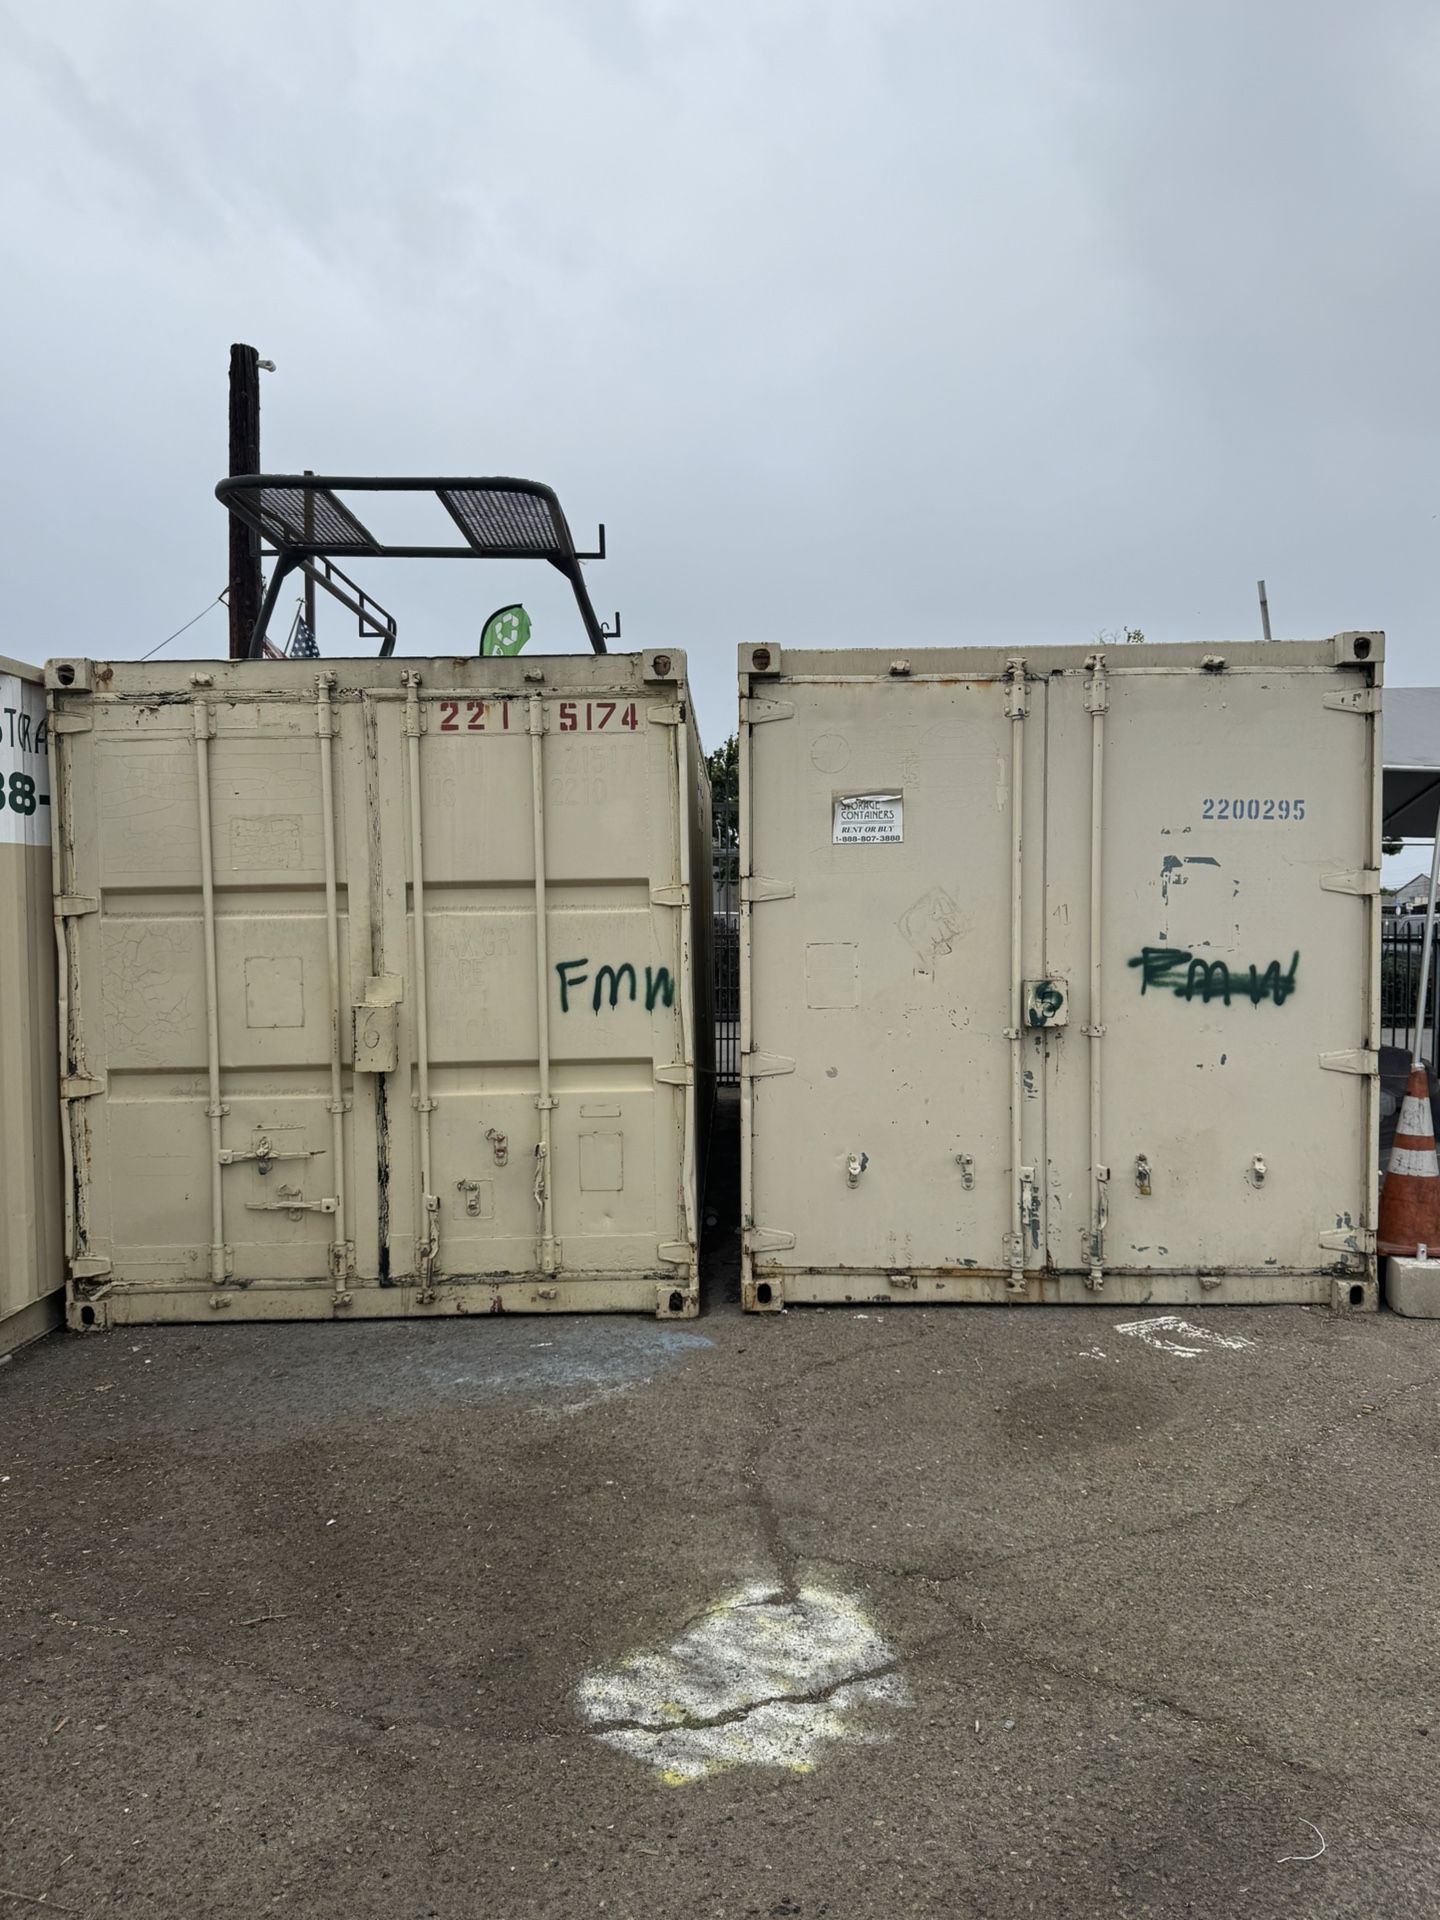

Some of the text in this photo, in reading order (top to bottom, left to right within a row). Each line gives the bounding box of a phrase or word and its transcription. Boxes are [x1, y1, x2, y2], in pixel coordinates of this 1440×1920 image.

[440, 702, 638, 731] 221 5174
[841, 810, 895, 820] CONTAINERS
[1202, 799, 1305, 820] 2200295
[878, 825, 894, 833] BUY
